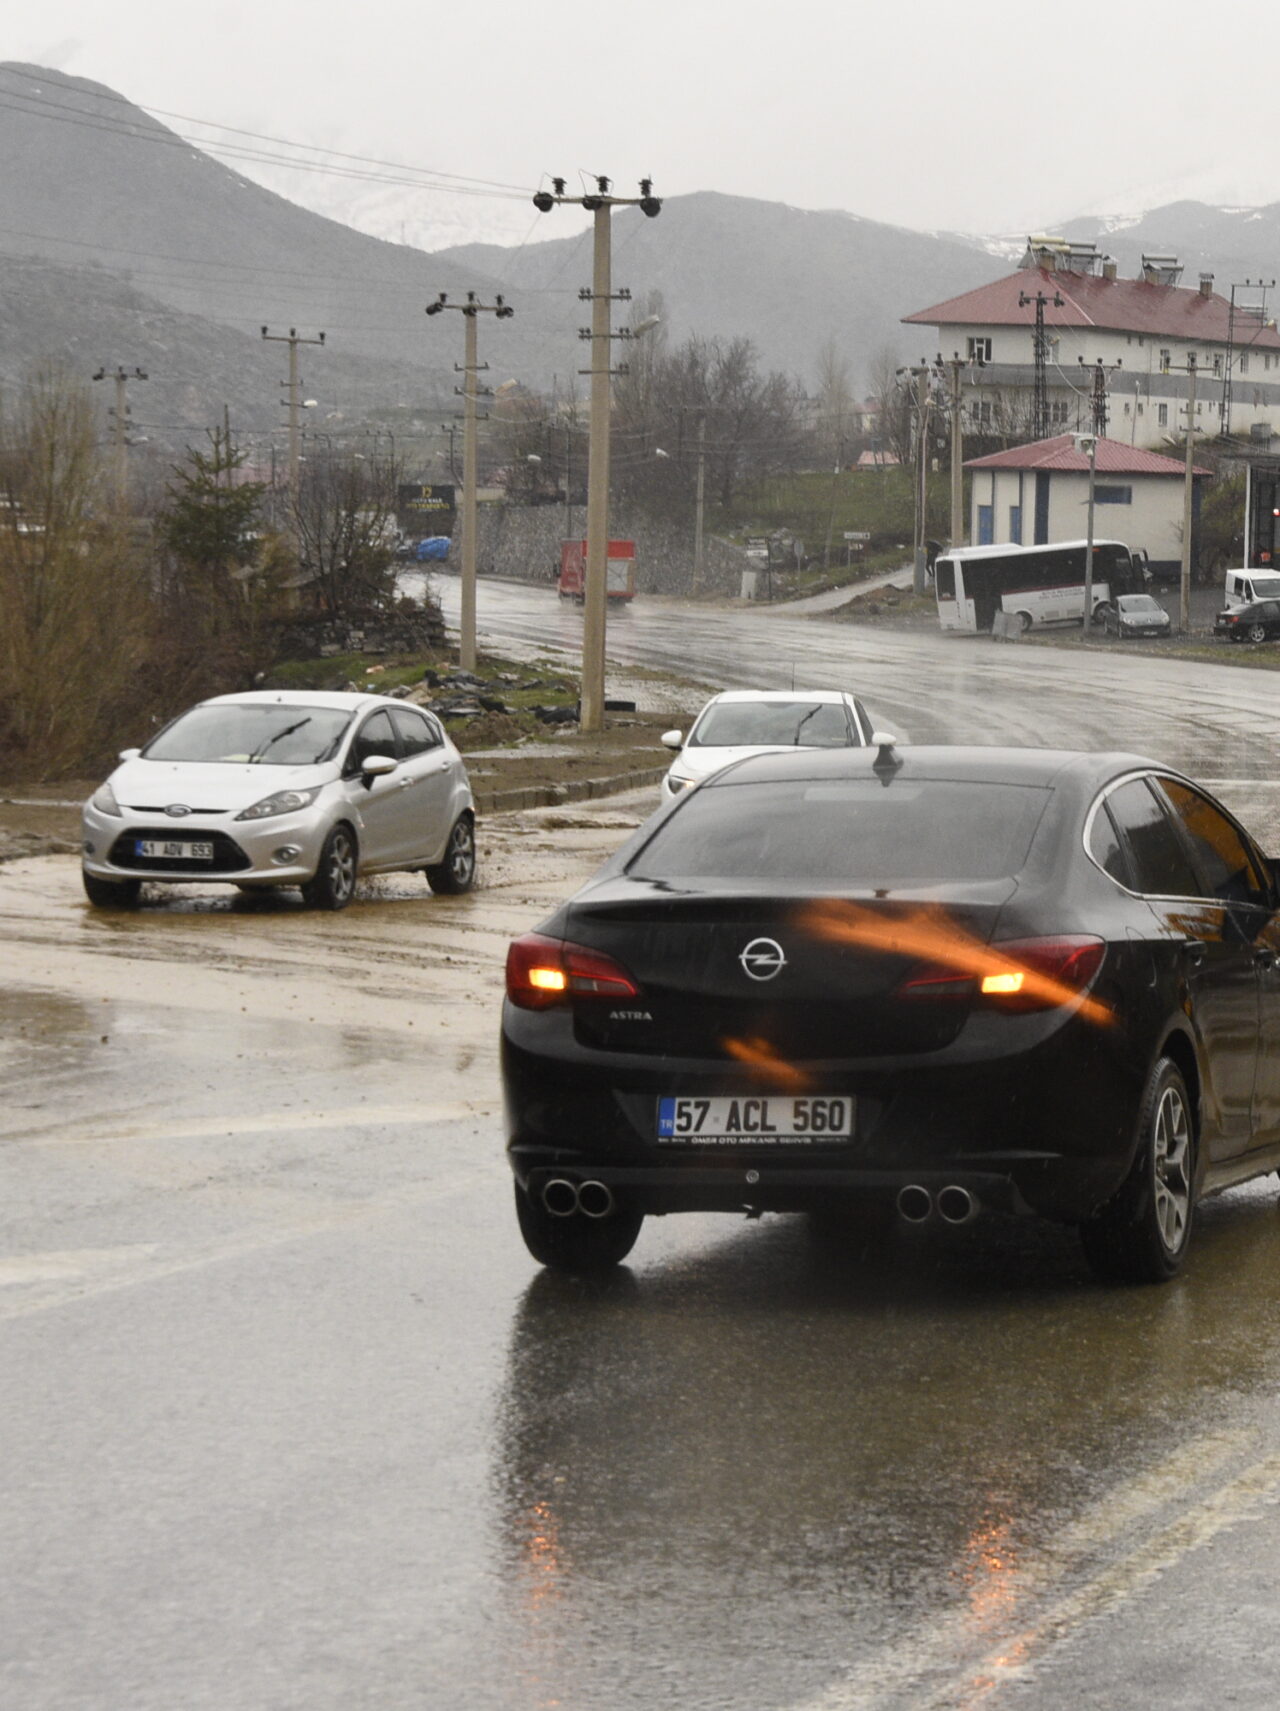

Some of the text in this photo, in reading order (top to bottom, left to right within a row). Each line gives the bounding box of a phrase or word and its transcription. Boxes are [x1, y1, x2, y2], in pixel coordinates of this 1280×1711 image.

[609, 1011, 653, 1020] ASTRA
[660, 1100, 846, 1132] TR 57 ACL 560
